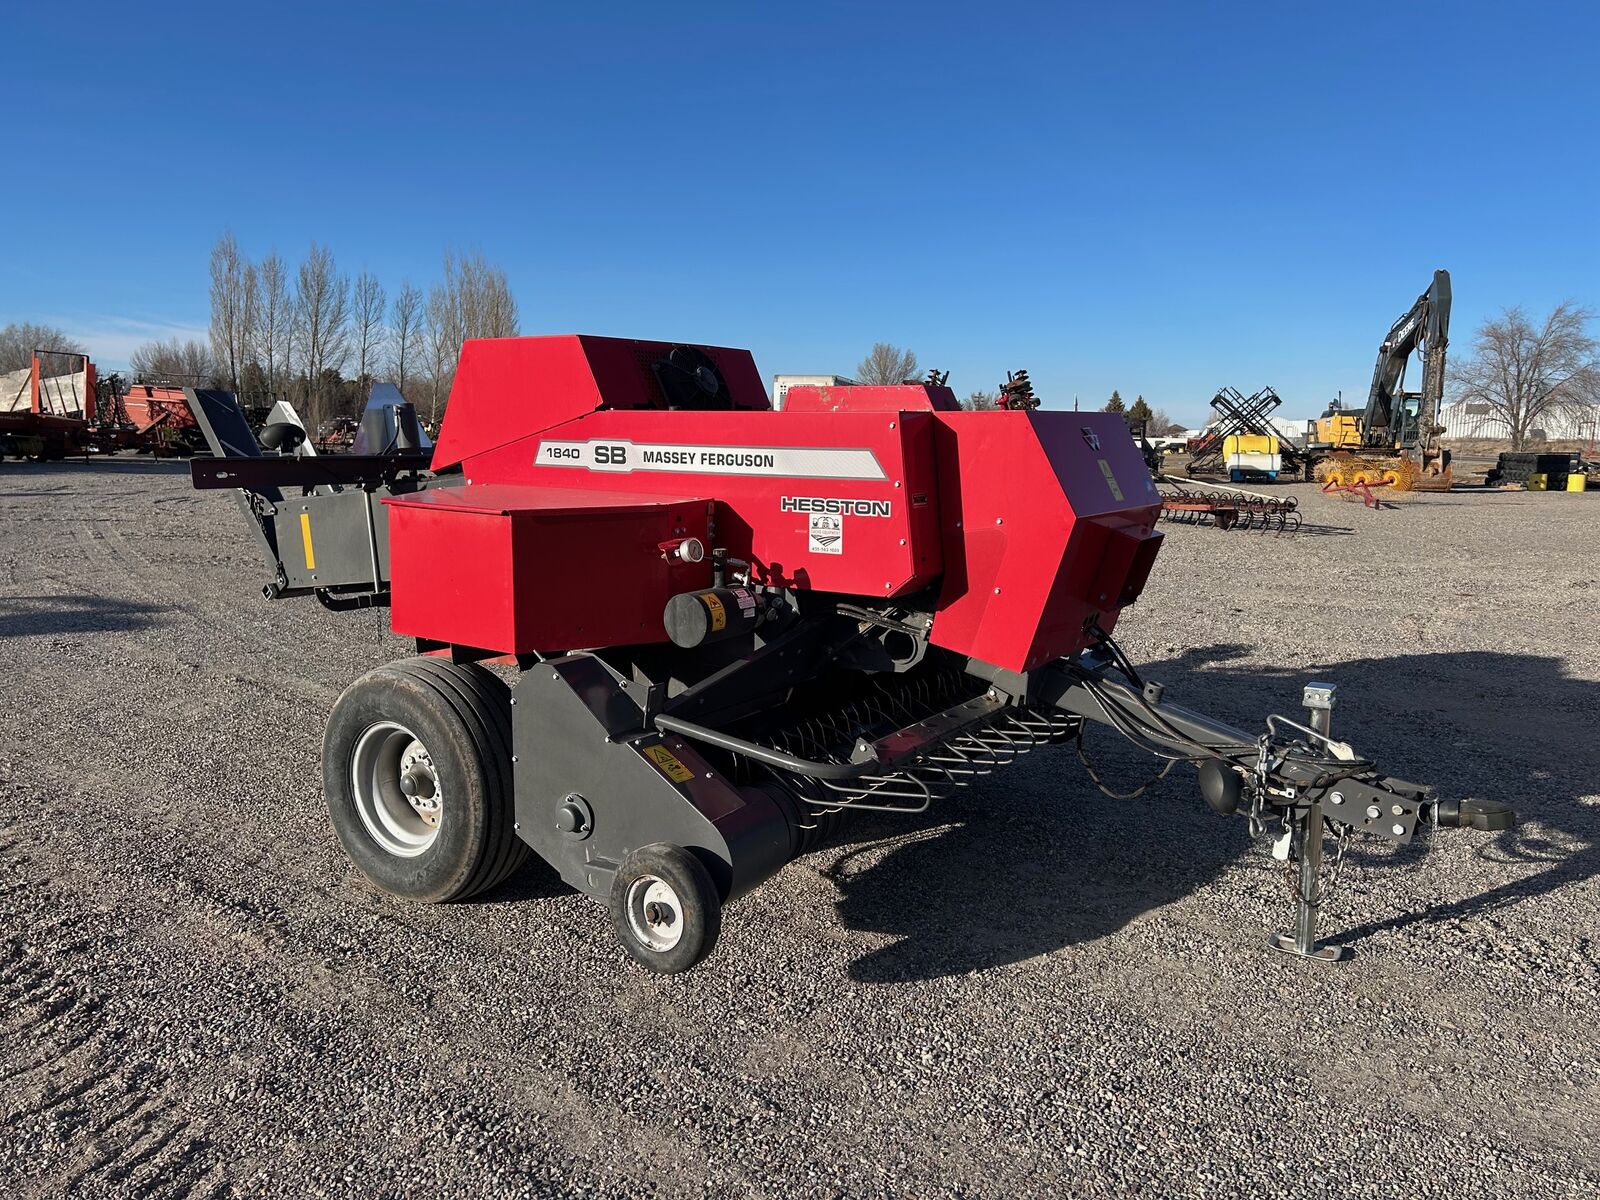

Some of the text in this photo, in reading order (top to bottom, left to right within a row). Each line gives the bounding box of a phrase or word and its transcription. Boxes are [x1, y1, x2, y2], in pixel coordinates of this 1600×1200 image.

[1398, 318, 1415, 342] DEERE
[546, 446, 774, 467] 1840 SB MASSEY FERGUSON
[781, 497, 891, 516] HESSTON
